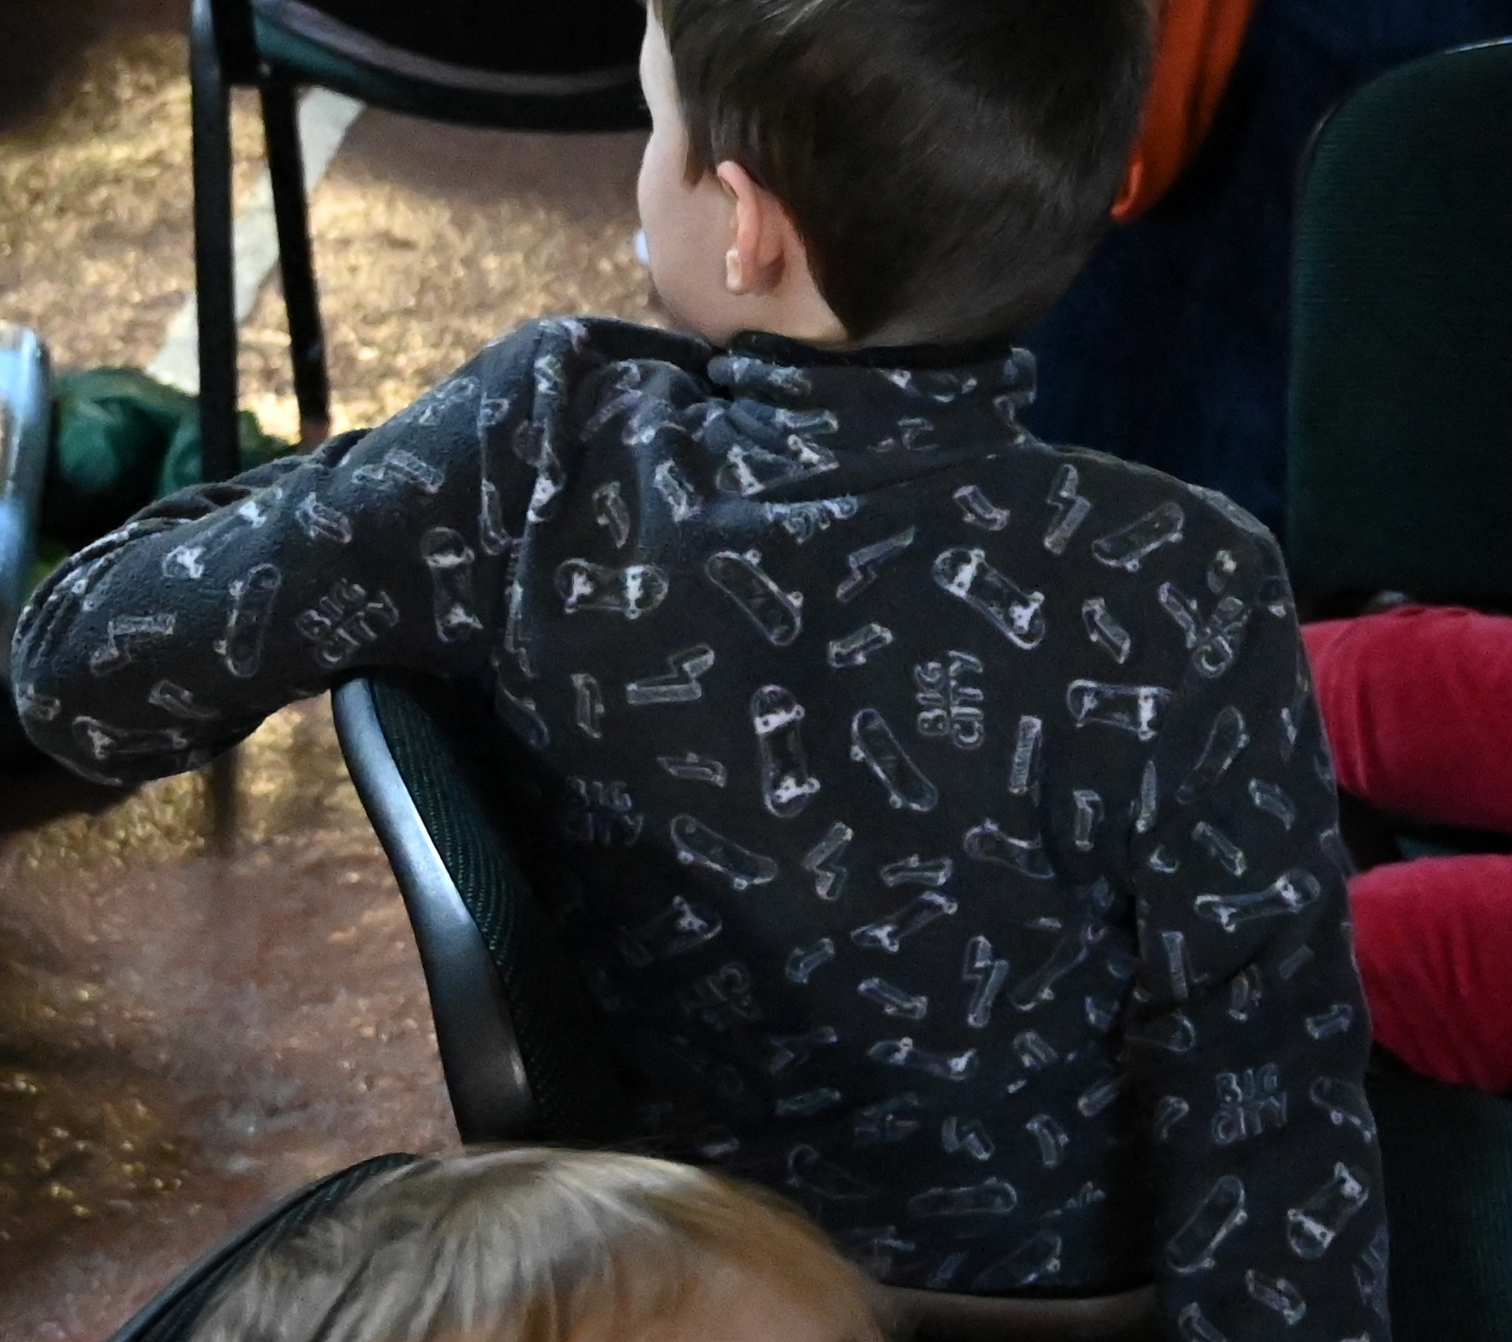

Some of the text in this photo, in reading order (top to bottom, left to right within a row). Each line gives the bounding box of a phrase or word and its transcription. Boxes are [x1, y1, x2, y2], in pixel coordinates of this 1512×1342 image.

[295, 577, 366, 641] BIG
[313, 590, 399, 670] CITY
[914, 661, 947, 736] BIG
[947, 649, 985, 751] CITY
[1215, 1062, 1280, 1103] BIG
[1210, 1091, 1287, 1146] CITY
